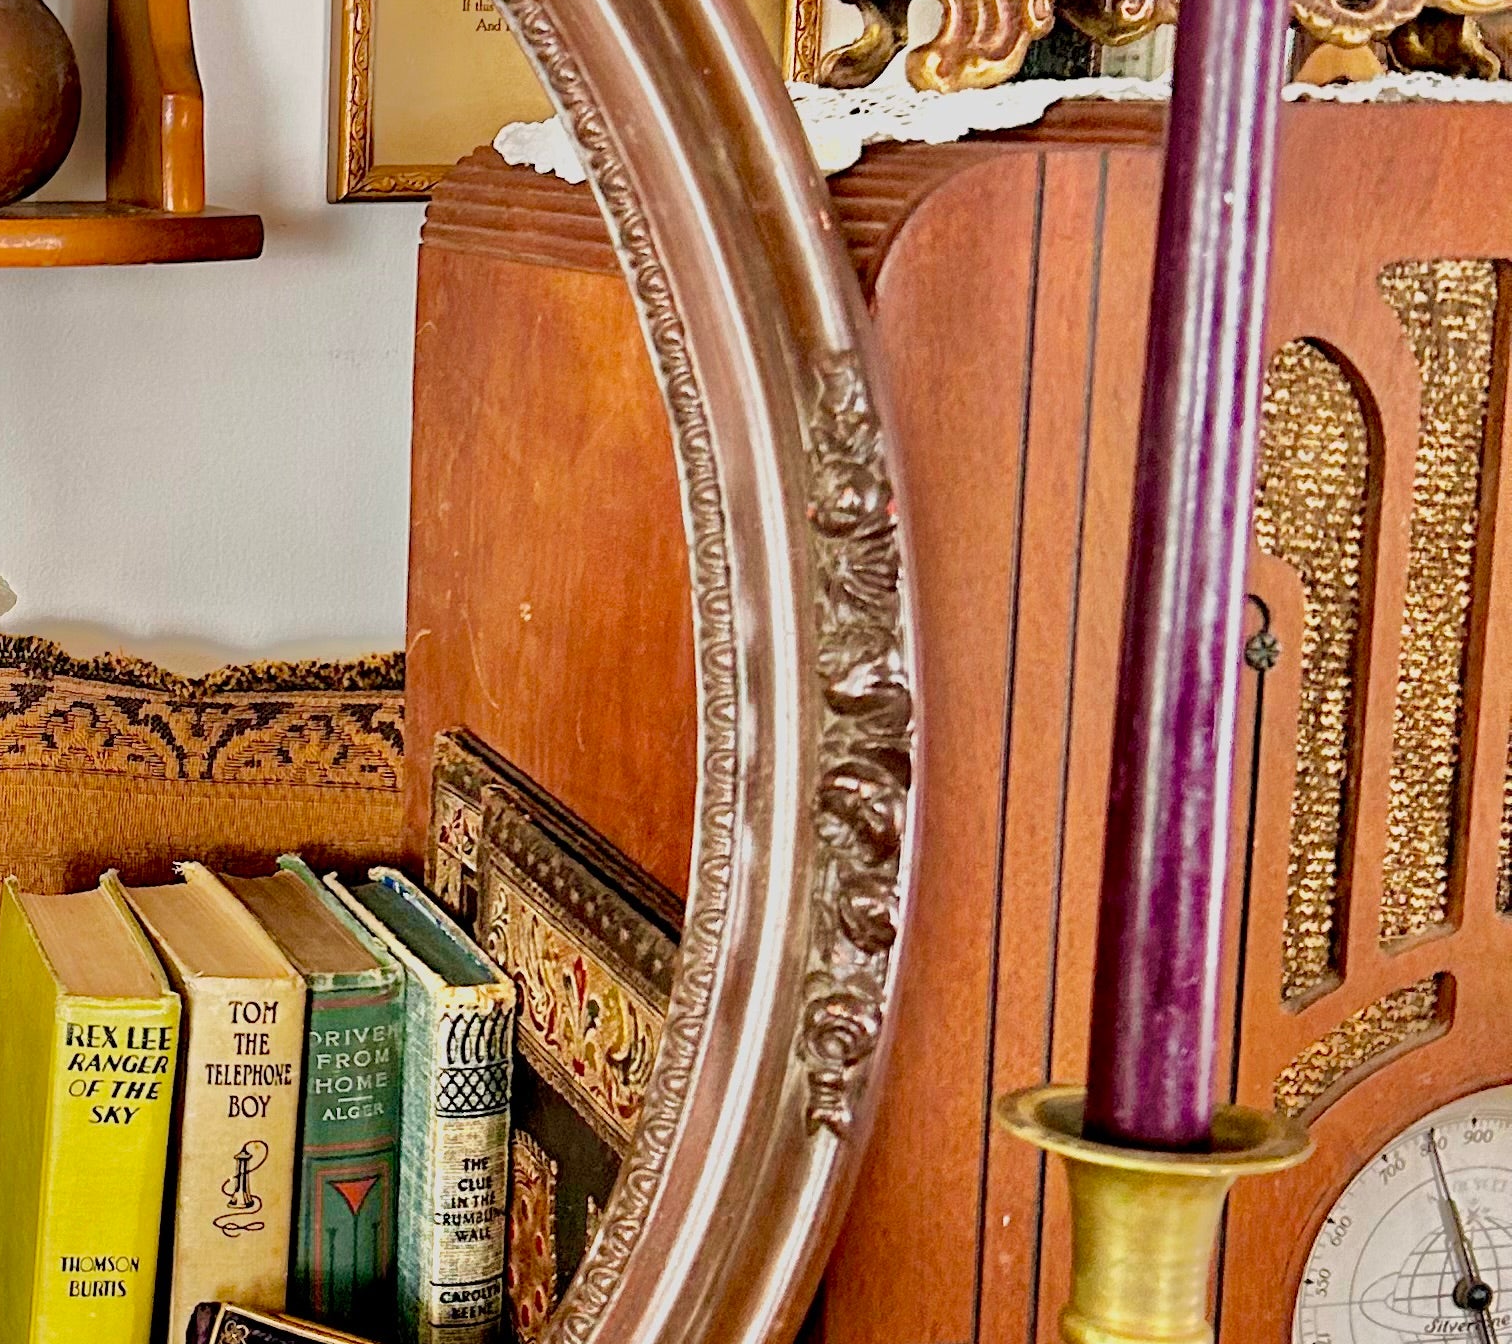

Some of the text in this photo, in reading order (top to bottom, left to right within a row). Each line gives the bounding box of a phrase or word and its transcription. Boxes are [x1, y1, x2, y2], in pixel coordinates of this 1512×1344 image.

[475, 18, 501, 32] And
[228, 1001, 279, 1024] TOM
[66, 1022, 173, 1051] REX LEE
[233, 1032, 270, 1055] THE
[67, 1053, 169, 1074] RANGER
[316, 1049, 390, 1069] FROM
[205, 1063, 292, 1086] TELEPHONE
[315, 1072, 389, 1094] HOME
[68, 1079, 163, 1100] OF THE
[88, 1105, 140, 1125] SKY
[227, 1095, 272, 1118] BOY
[322, 1103, 384, 1120] ALGER
[1462, 1129, 1494, 1145] 900
[461, 1157, 490, 1172] THE
[1378, 1157, 1406, 1185] 700
[451, 1196, 468, 1209] IN
[1329, 1215, 1353, 1248] 600
[60, 1256, 139, 1272] THOMSON
[69, 1280, 127, 1297] BURTIS
[1314, 1267, 1332, 1297] 550
